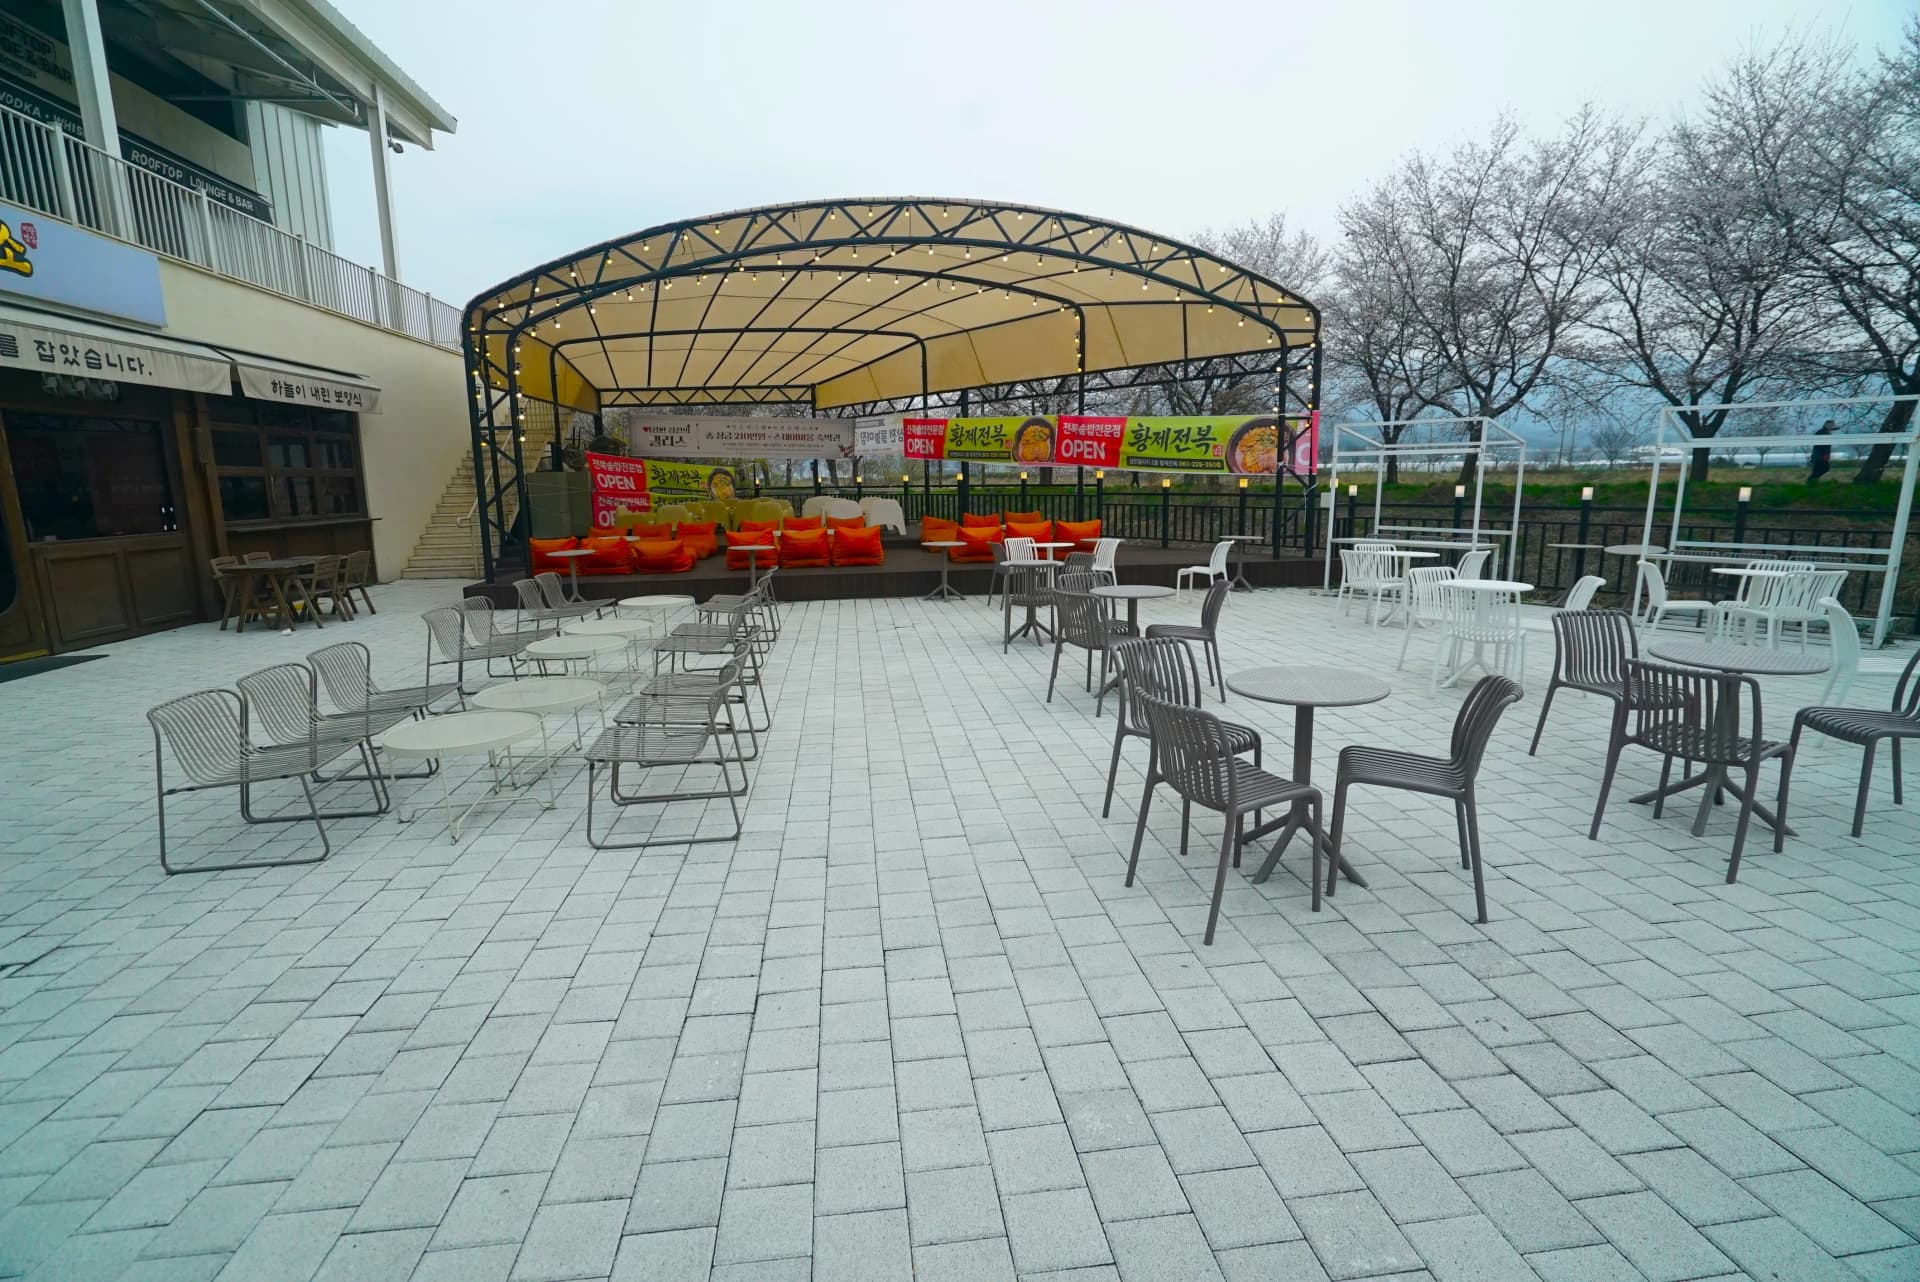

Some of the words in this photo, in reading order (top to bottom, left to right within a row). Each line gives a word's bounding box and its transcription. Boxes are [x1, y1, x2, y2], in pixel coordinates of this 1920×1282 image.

[131, 150, 183, 180] ROOFTOP
[190, 175, 227, 201] LOUNGE
[228, 192, 236, 203] &
[235, 196, 254, 211] BAR
[33, 339, 153, 377] 잡았습니다.
[270, 379, 306, 399] 하늘이
[310, 385, 331, 404] 내린
[334, 389, 363, 408] 보양식
[907, 438, 934, 455] OPEN
[949, 423, 1007, 448] 황제전복
[1127, 422, 1217, 455] 황제전복
[1061, 438, 1106, 460] OPEN
[596, 473, 636, 490] OPEN
[651, 465, 702, 488] 황제전복
